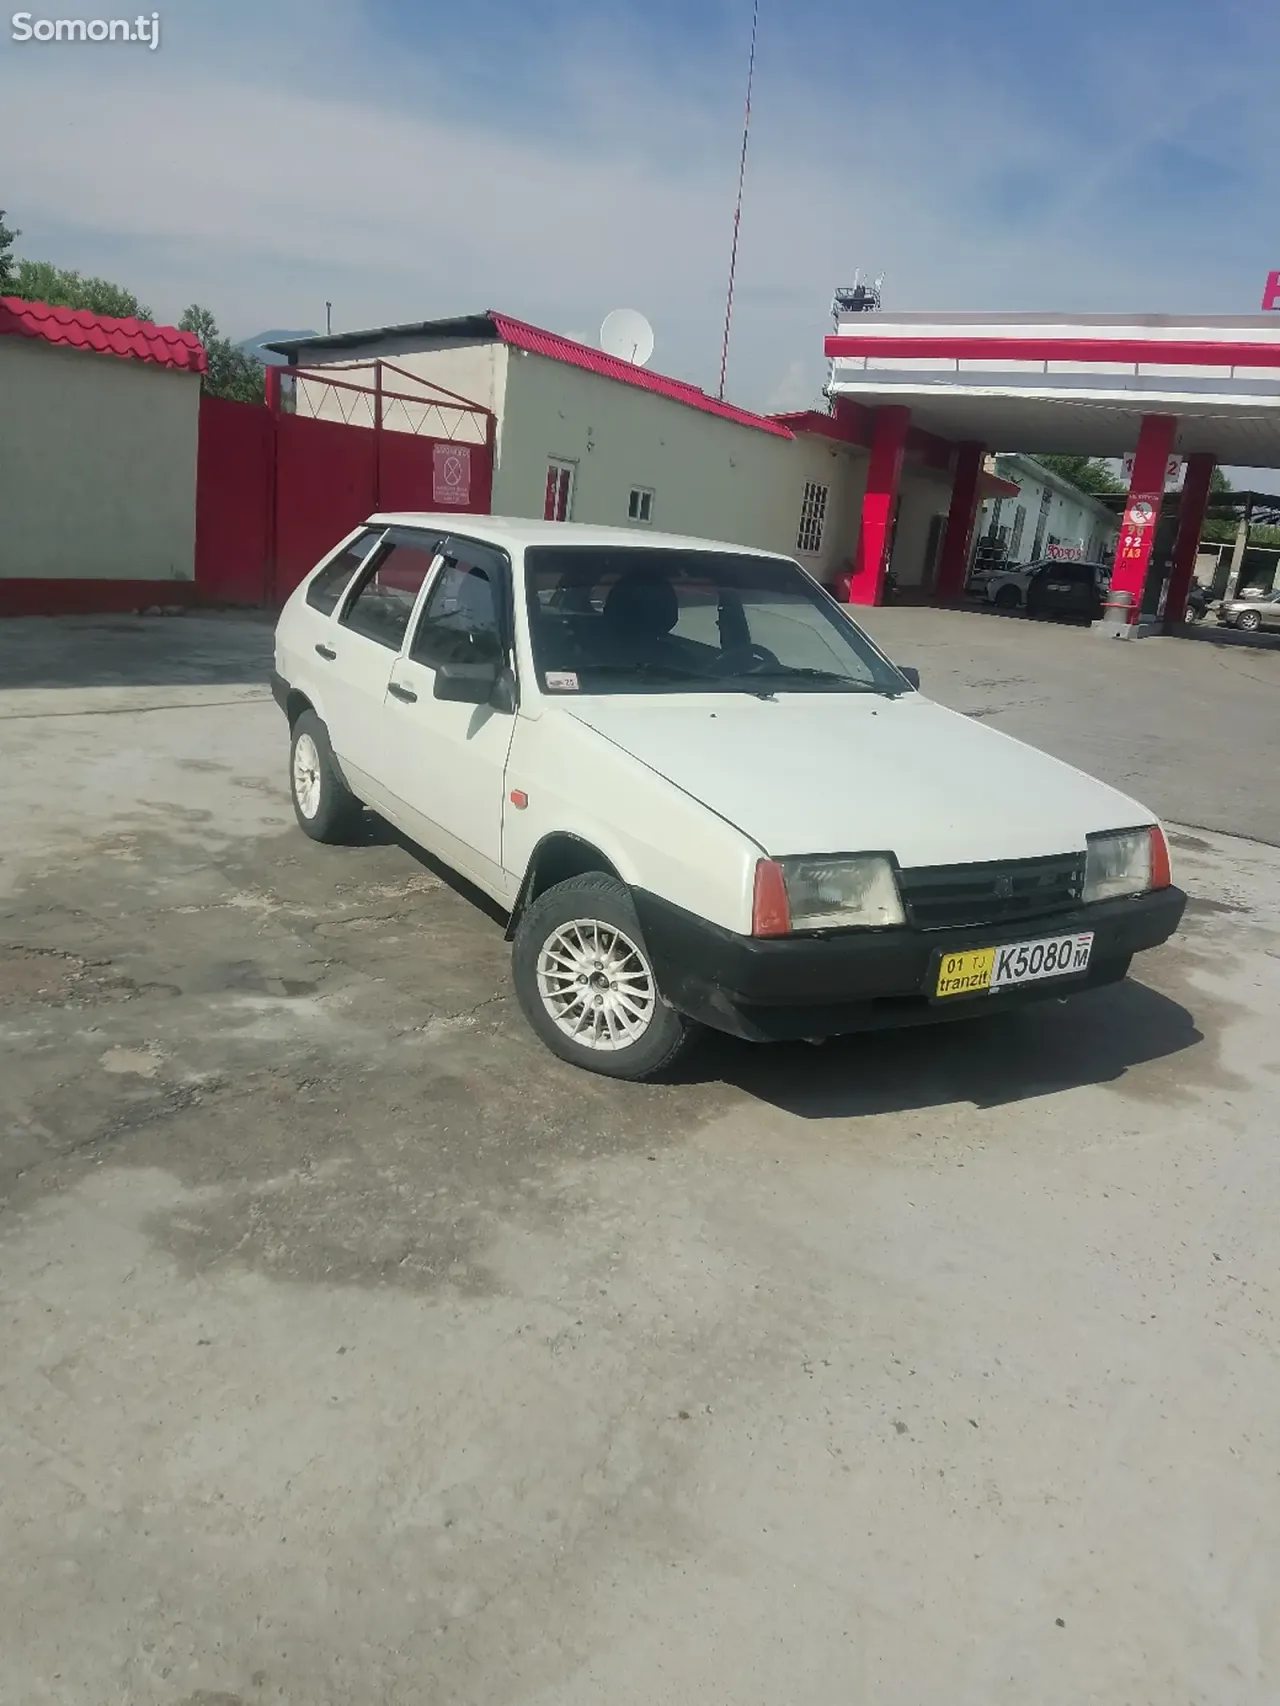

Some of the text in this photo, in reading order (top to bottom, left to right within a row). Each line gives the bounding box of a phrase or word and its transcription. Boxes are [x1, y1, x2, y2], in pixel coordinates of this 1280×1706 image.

[1167, 461, 1178, 475] 2
[1124, 536, 1141, 547] 92
[1122, 548, 1141, 558] ГАЗ
[947, 956, 986, 974] 01 TJ
[996, 940, 1088, 981] K5080 M
[940, 971, 988, 992] tranzit
